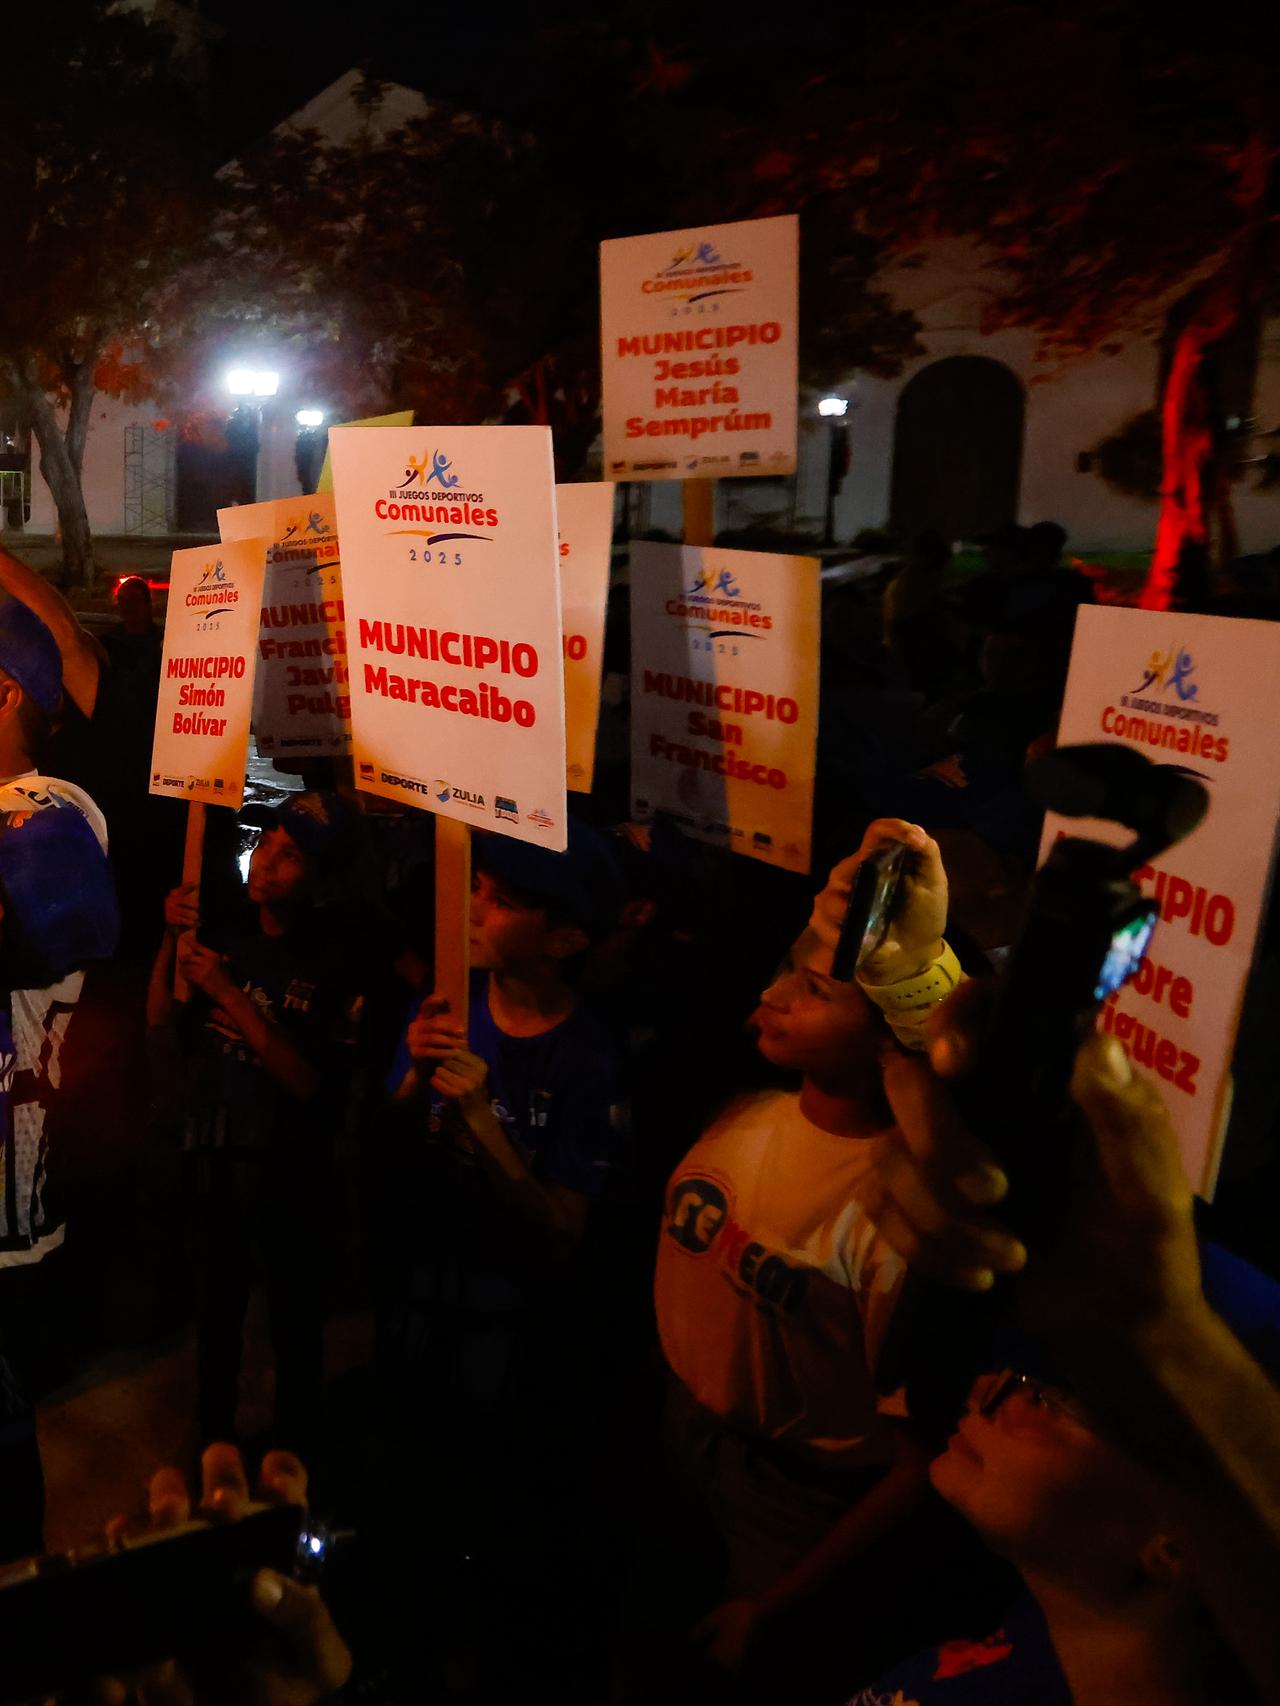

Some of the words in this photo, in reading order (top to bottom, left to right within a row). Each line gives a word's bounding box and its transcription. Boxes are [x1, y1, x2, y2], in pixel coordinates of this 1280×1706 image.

[617, 321, 782, 358] MUNICIPIO
[654, 352, 741, 381] Jesús
[654, 381, 740, 408] María
[625, 408, 772, 440] Semprúm
[399, 491, 429, 500] JUEGOS
[432, 492, 484, 503] DEPORTIVOS
[375, 499, 499, 527] Comunales
[185, 589, 239, 607] Comunales
[665, 599, 773, 629] Comunales
[260, 631, 346, 660] Franci
[359, 618, 539, 678] MUNICIPIO
[167, 656, 246, 680] MUNICIPIO
[179, 683, 225, 707] Simón
[364, 663, 536, 728] Maracaibo
[644, 670, 799, 724] MUNICIPIO
[172, 712, 227, 737] Bolívar
[687, 711, 743, 745] San
[1102, 706, 1229, 762] Comunales
[650, 734, 786, 790] Francisco
[380, 773, 428, 795] DEPORTE
[451, 788, 485, 806] ZULIA
